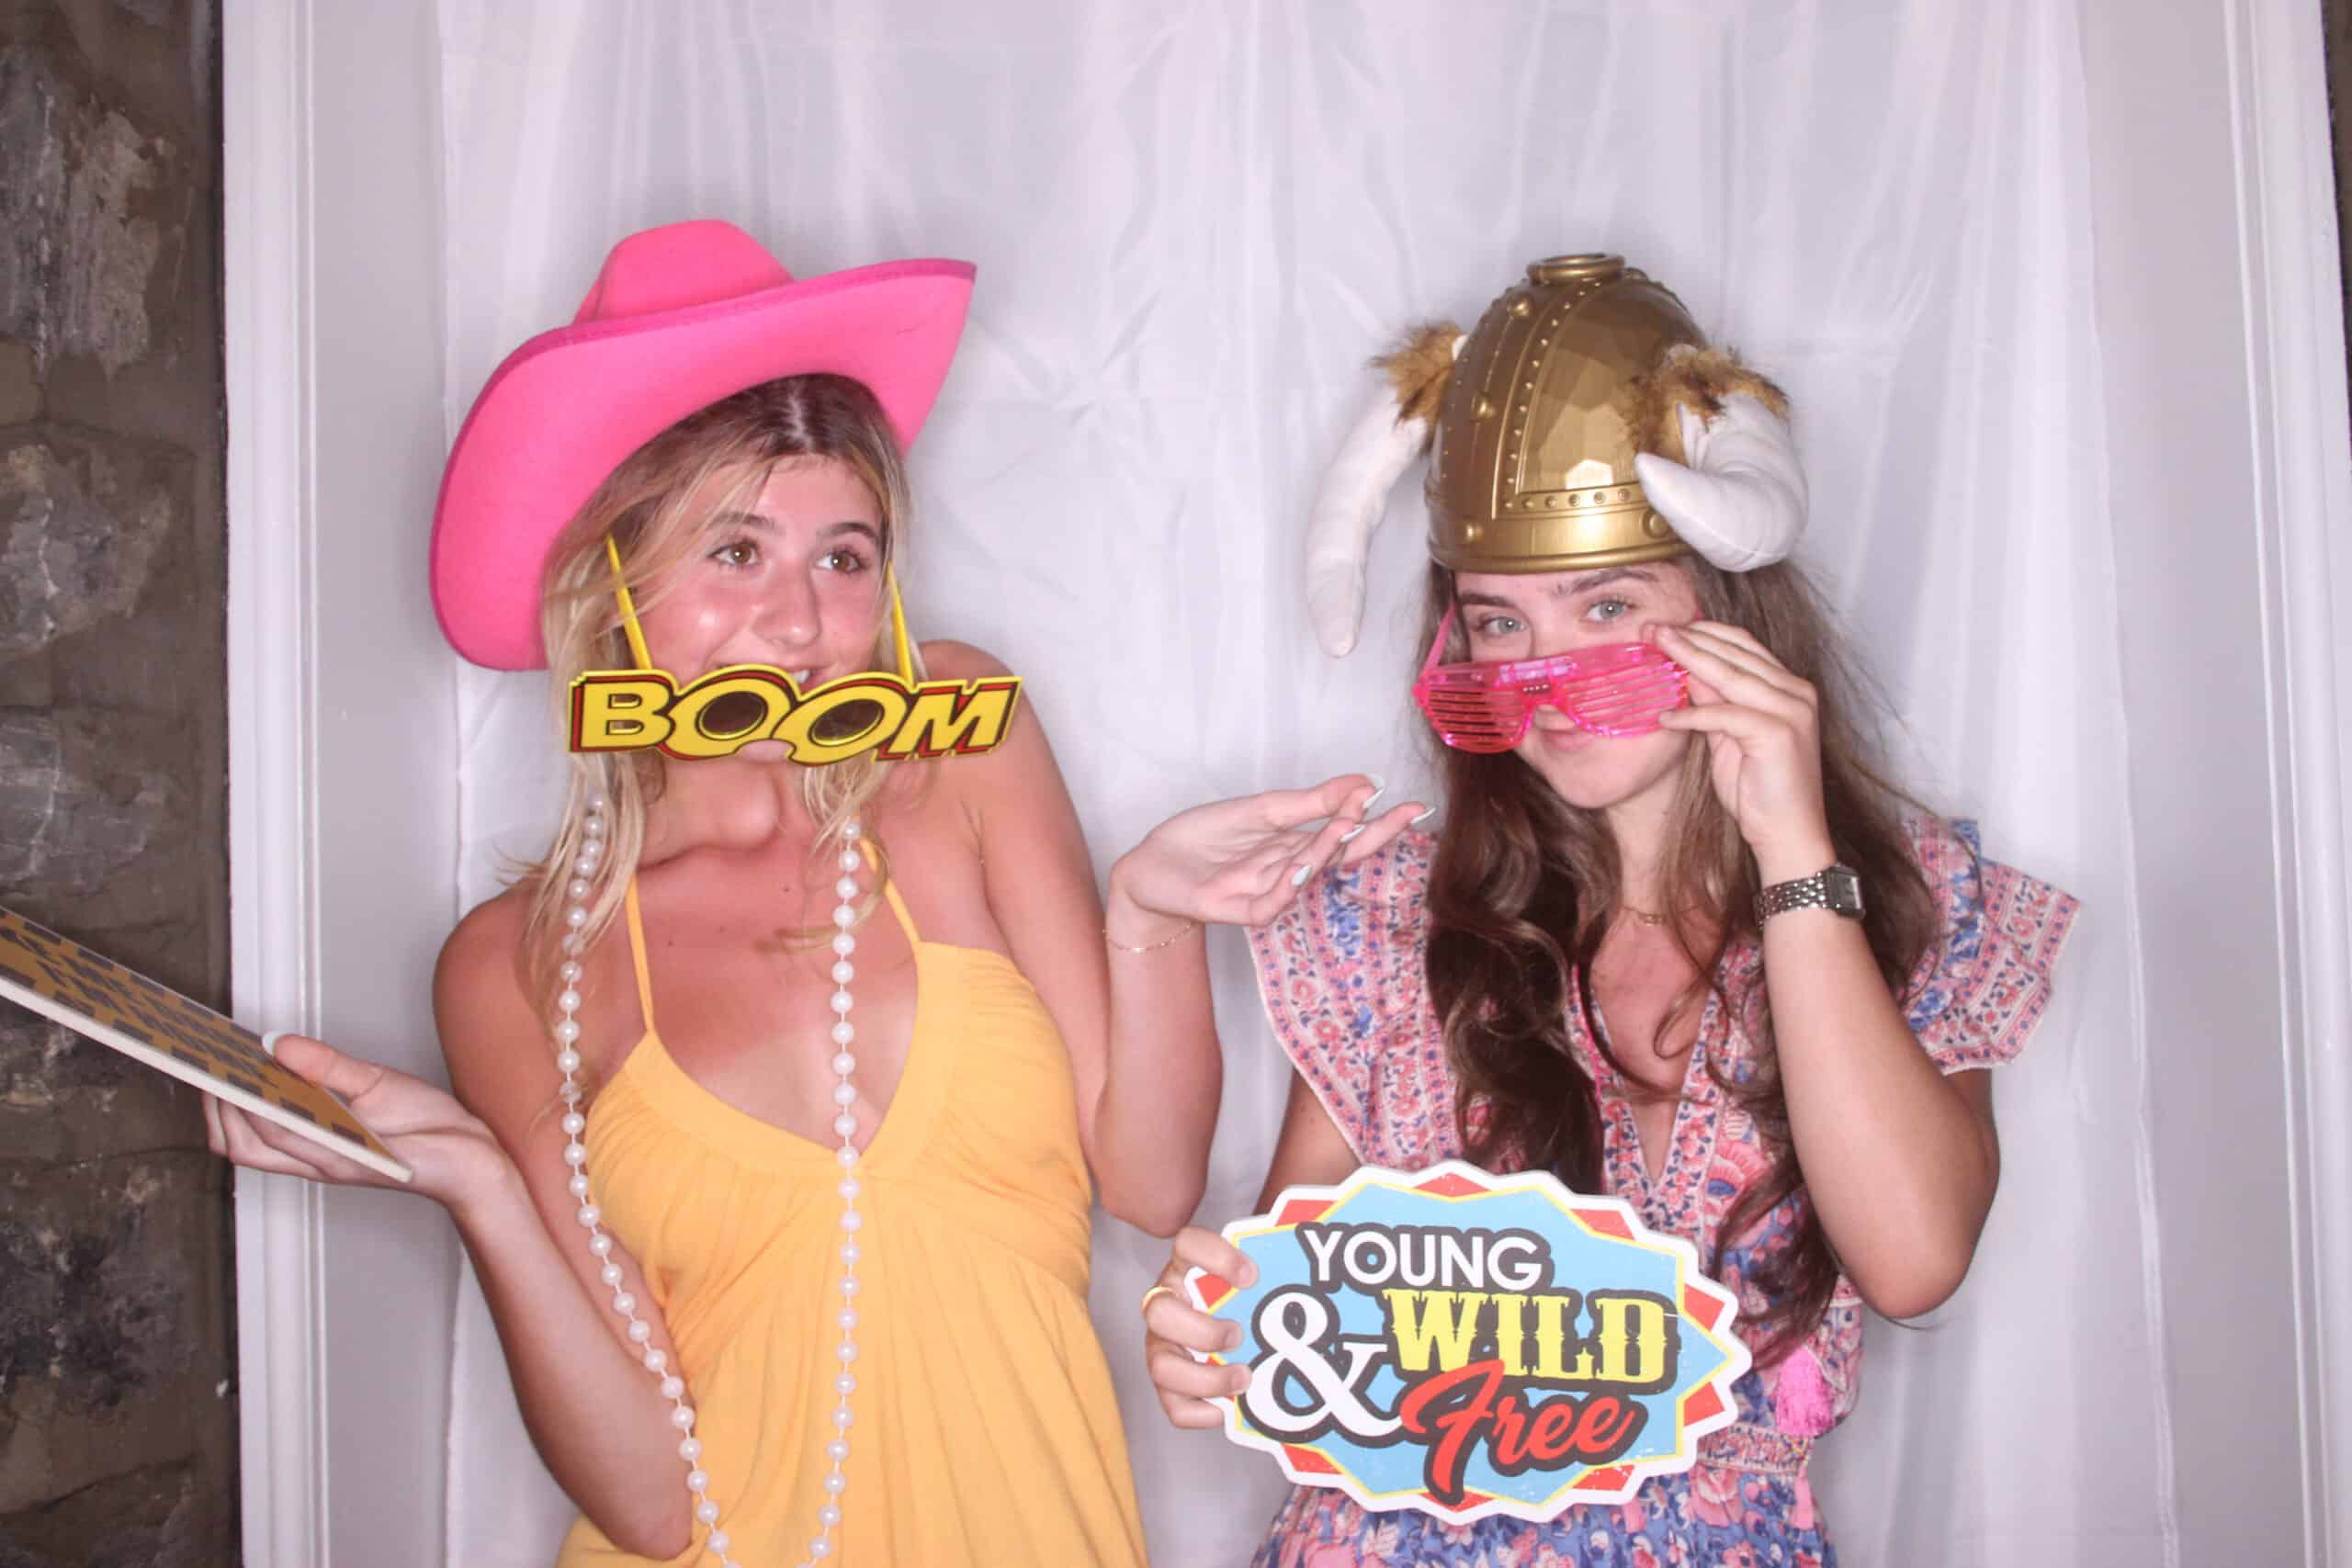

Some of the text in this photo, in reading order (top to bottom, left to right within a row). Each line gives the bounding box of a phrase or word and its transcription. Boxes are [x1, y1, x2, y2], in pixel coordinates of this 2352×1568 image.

[570, 667, 1020, 764] BOOM
[1306, 1229, 1543, 1290] YOUNG
[1245, 1289, 1666, 1438] & WILD
[1401, 1359, 1635, 1495] Free
